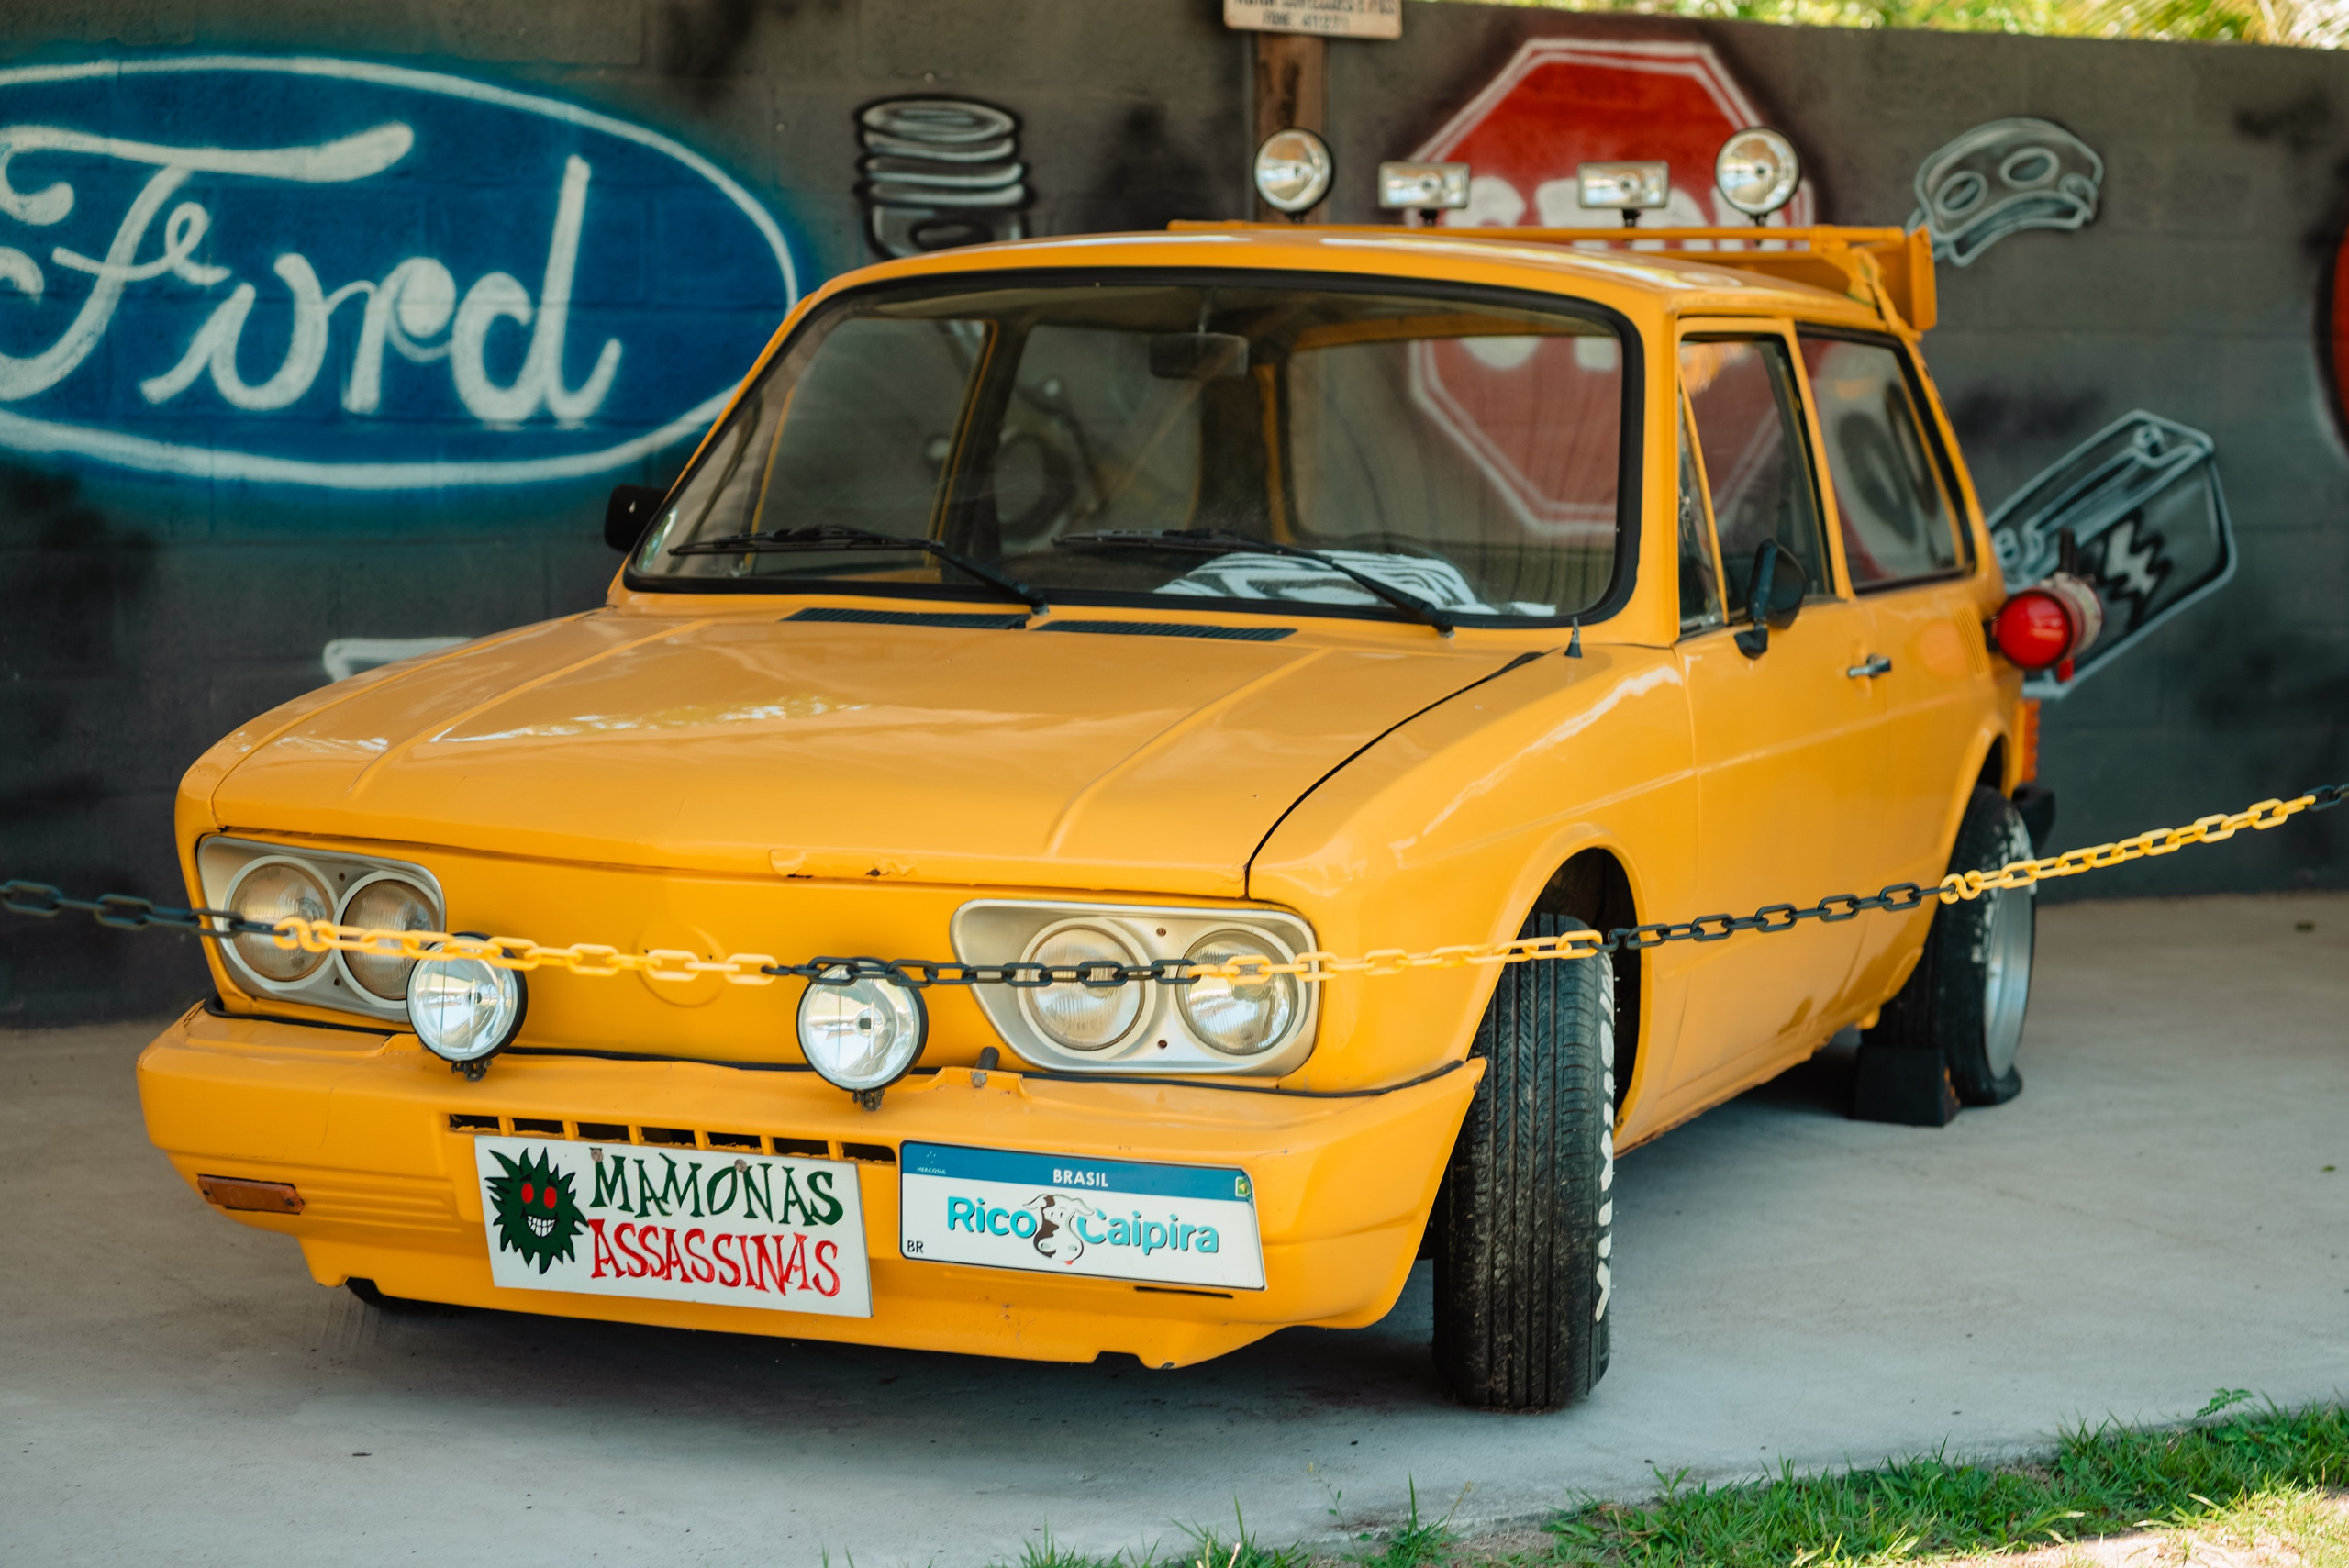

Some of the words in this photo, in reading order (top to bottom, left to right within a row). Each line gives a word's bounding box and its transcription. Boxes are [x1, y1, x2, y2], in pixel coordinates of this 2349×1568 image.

[0, 120, 623, 430] Ford
[588, 1147, 844, 1227] MAMONAS
[1052, 1168, 1108, 1188] BRASIL
[586, 1218, 841, 1298] ASSASSINAS
[907, 1240, 924, 1254] BR
[946, 1195, 1038, 1240] Rico
[1076, 1207, 1220, 1256] Caipira
